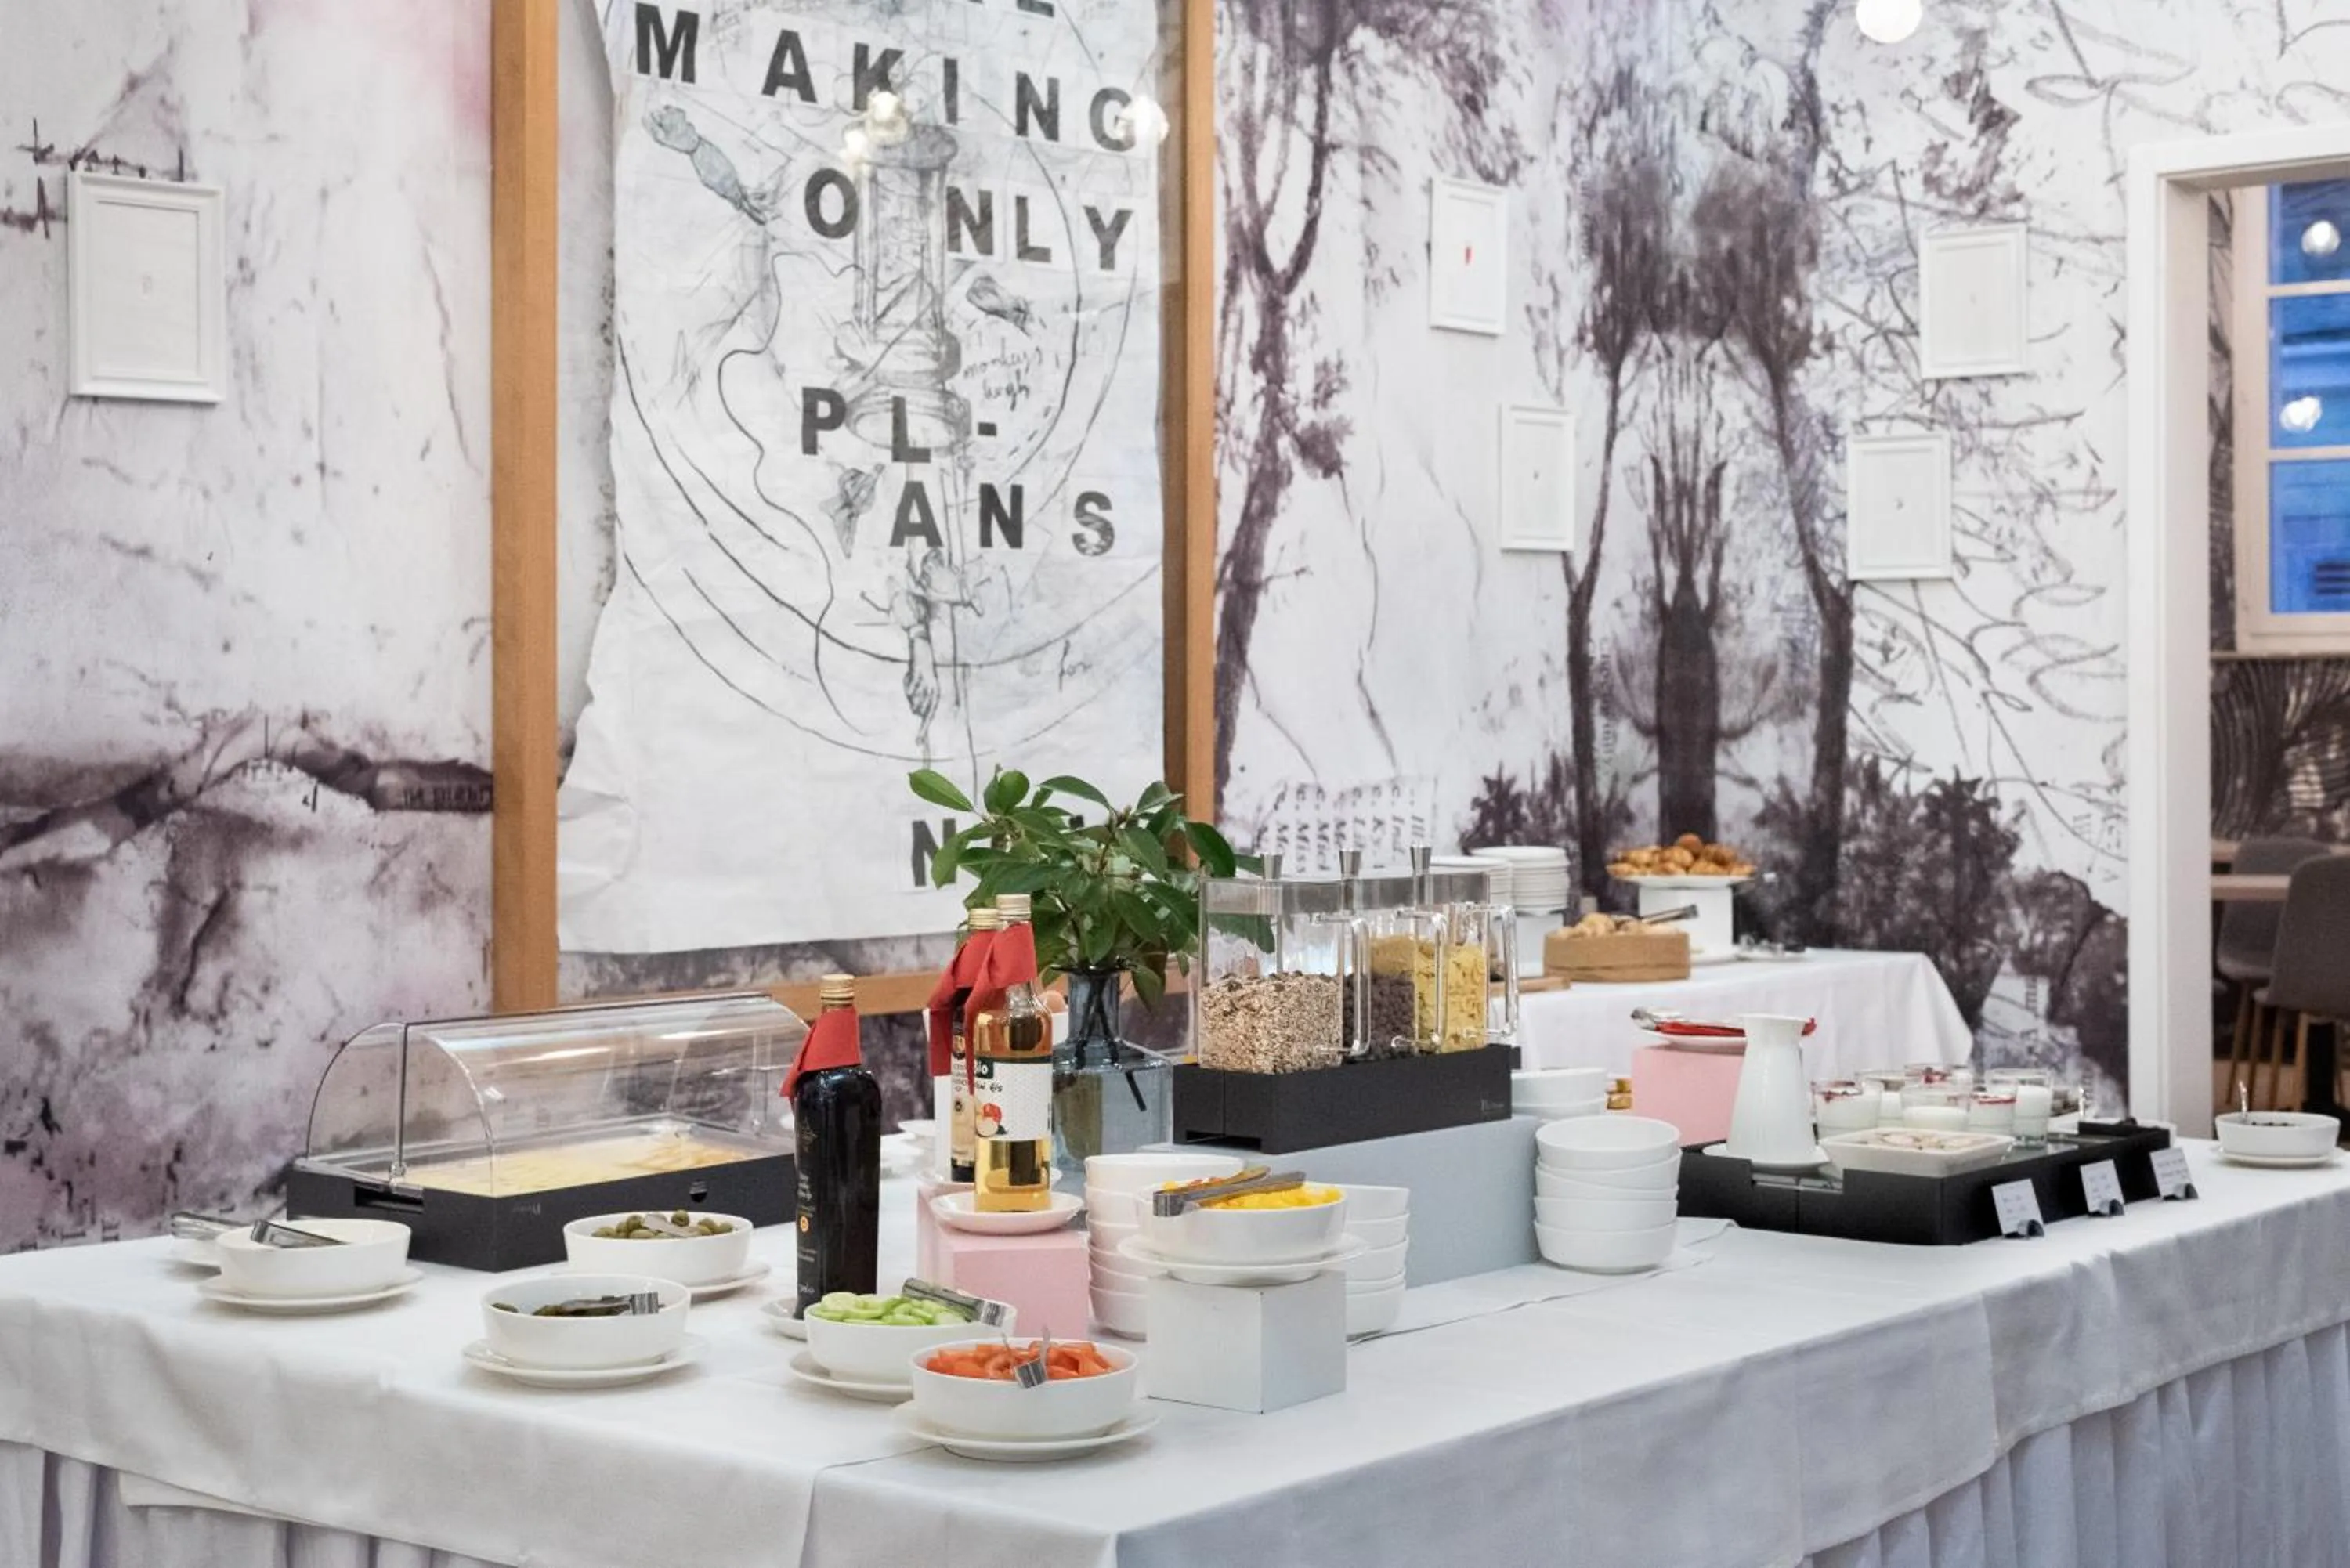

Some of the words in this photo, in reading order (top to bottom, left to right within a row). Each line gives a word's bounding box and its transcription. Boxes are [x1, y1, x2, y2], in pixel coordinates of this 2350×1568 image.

[634, 2, 1133, 152] MAKING
[804, 168, 1133, 272] ONLY
[889, 480, 1115, 556] ANS
